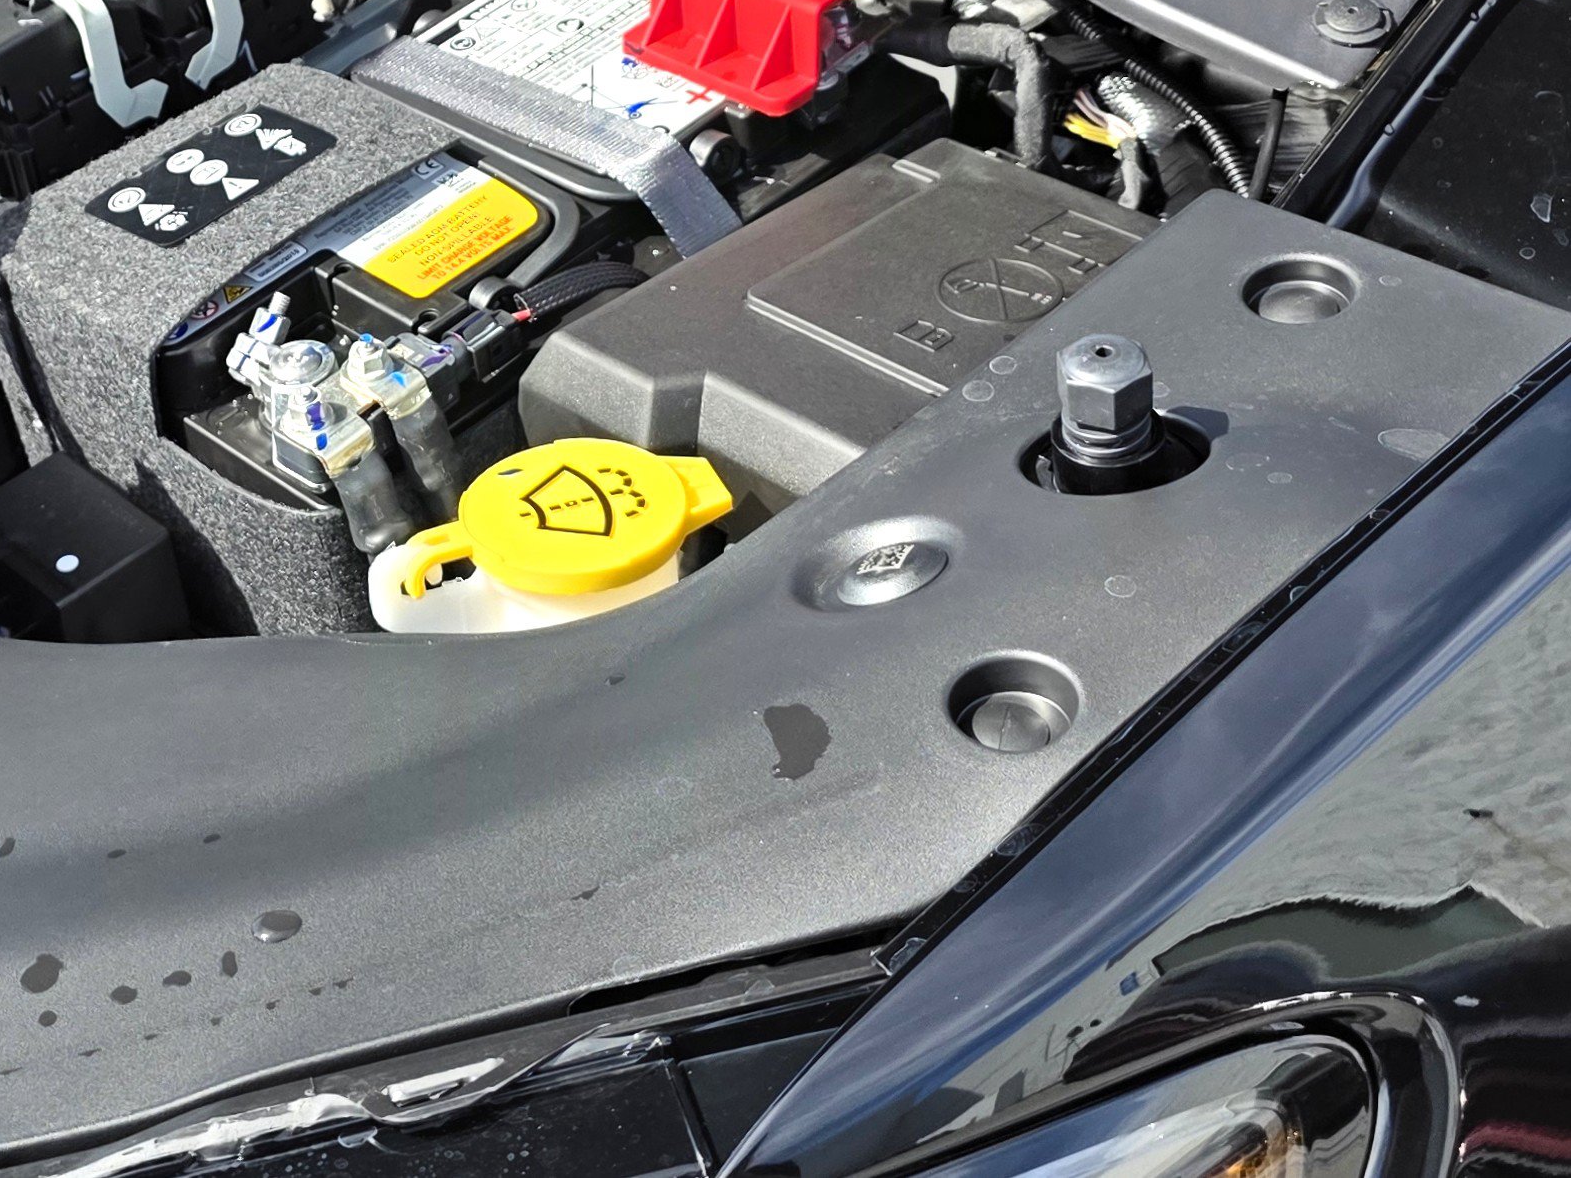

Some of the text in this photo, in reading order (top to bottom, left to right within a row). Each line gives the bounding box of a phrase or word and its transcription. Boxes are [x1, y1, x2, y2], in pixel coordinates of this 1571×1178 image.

[388, 236, 425, 263] SEALED
[447, 196, 489, 224] BATTERY
[414, 243, 429, 257] DO
[429, 231, 452, 251] NOT
[417, 214, 513, 280] LIMIT CHARGE VOLTAGE
[432, 267, 447, 280] TO
[463, 241, 493, 262] VOLTS
